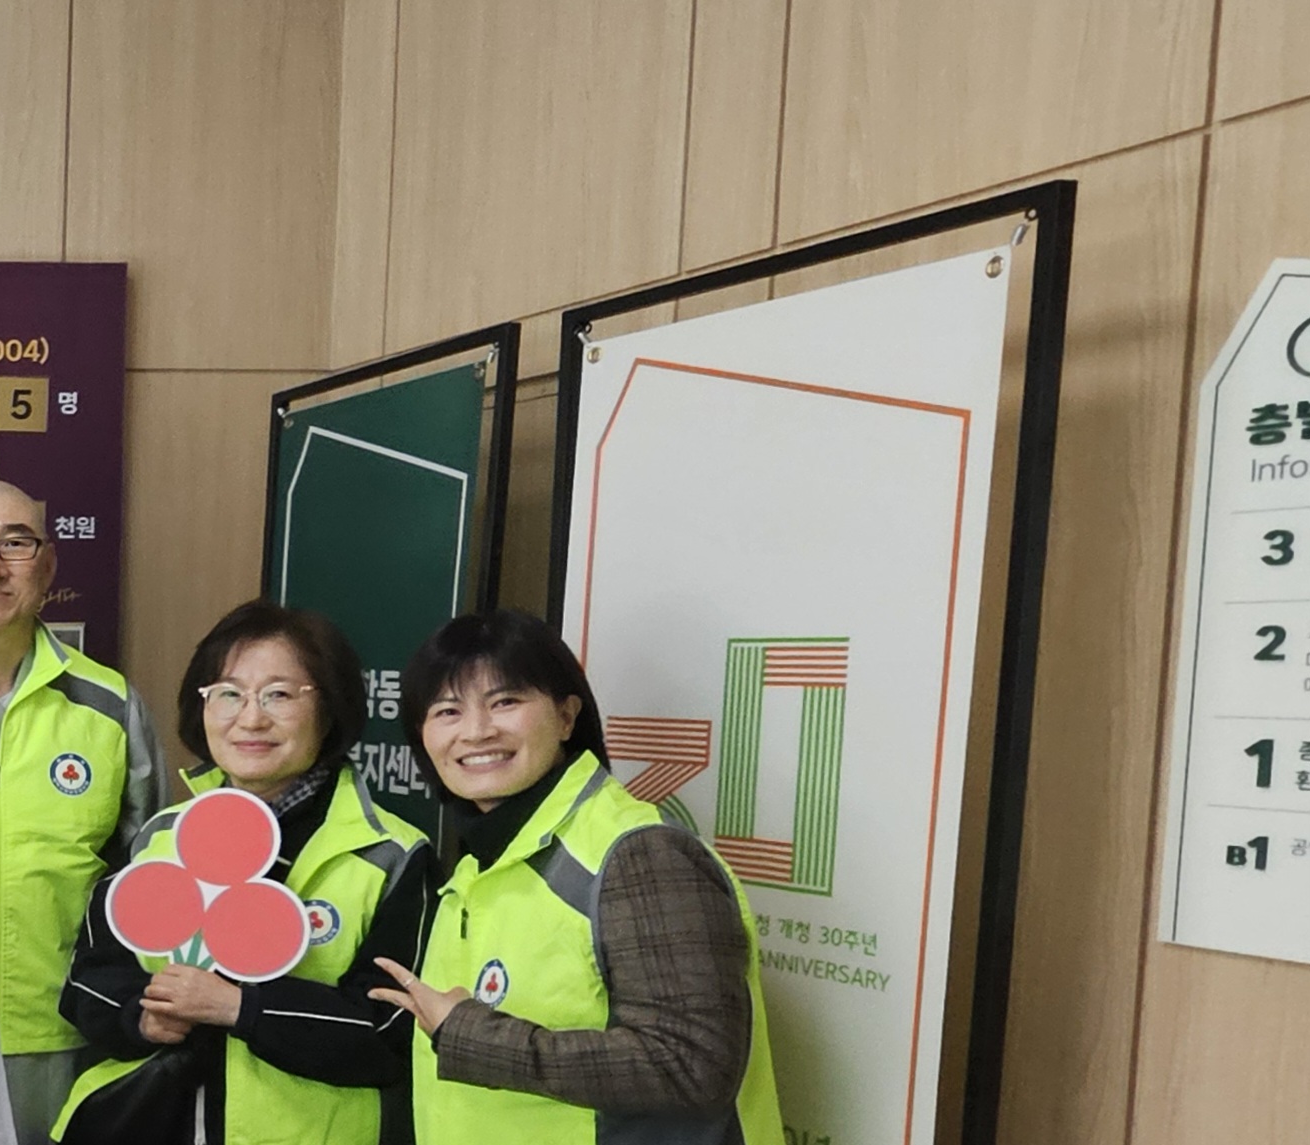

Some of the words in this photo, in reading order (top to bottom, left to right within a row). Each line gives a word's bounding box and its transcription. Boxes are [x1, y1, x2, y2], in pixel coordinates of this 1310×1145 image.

[58, 391, 79, 415] 명
[55, 516, 96, 540] 천원
[1260, 529, 1295, 566] 3
[1253, 625, 1287, 662] 2
[1243, 738, 1275, 788] 1
[1226, 836, 1269, 871] B1
[819, 925, 878, 957] 30주년
[758, 948, 891, 992] ANNIVERSARY
